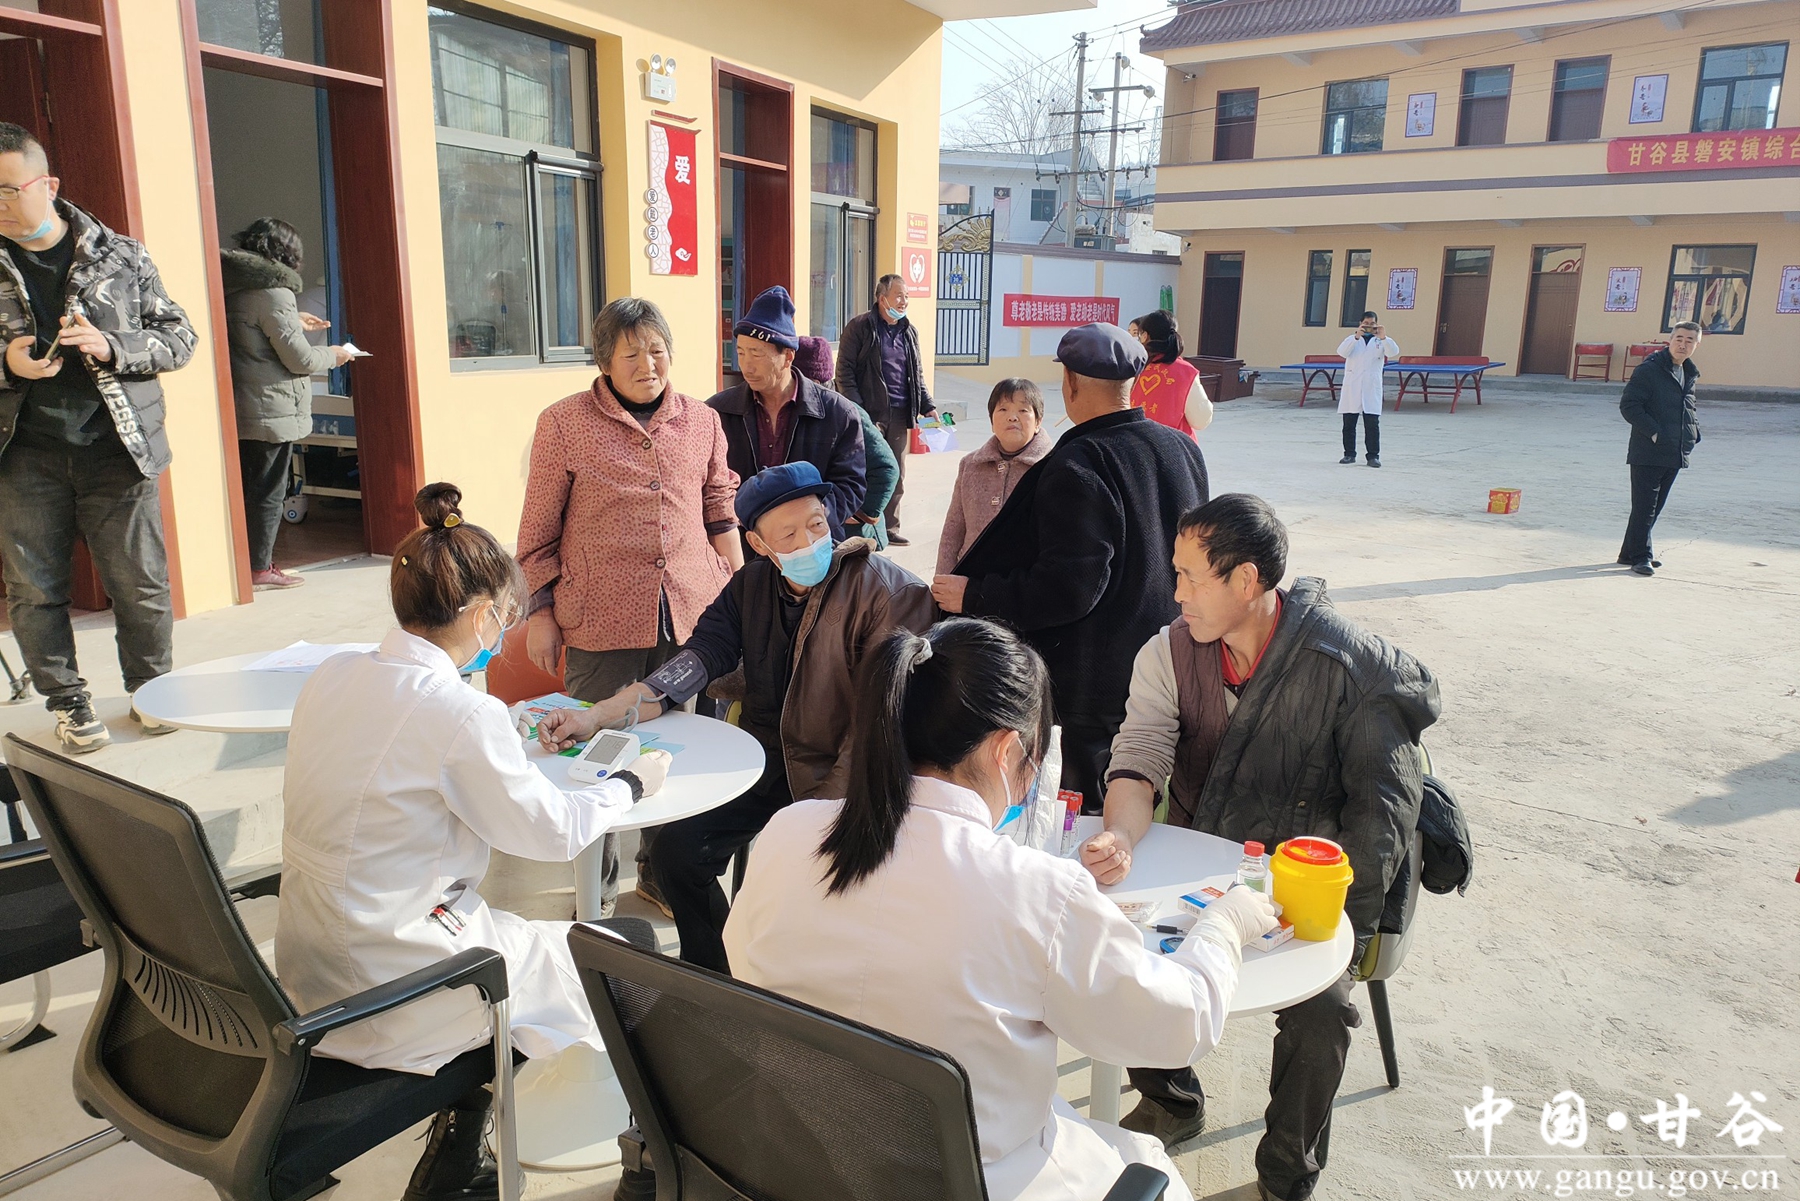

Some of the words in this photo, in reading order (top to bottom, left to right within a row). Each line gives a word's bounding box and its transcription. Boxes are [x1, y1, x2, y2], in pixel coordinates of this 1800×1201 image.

[1628, 134, 1800, 166] 甘谷县磐安镇综合
[674, 155, 691, 185] 爱
[1011, 300, 1067, 321] 尊老敬老是传统美德
